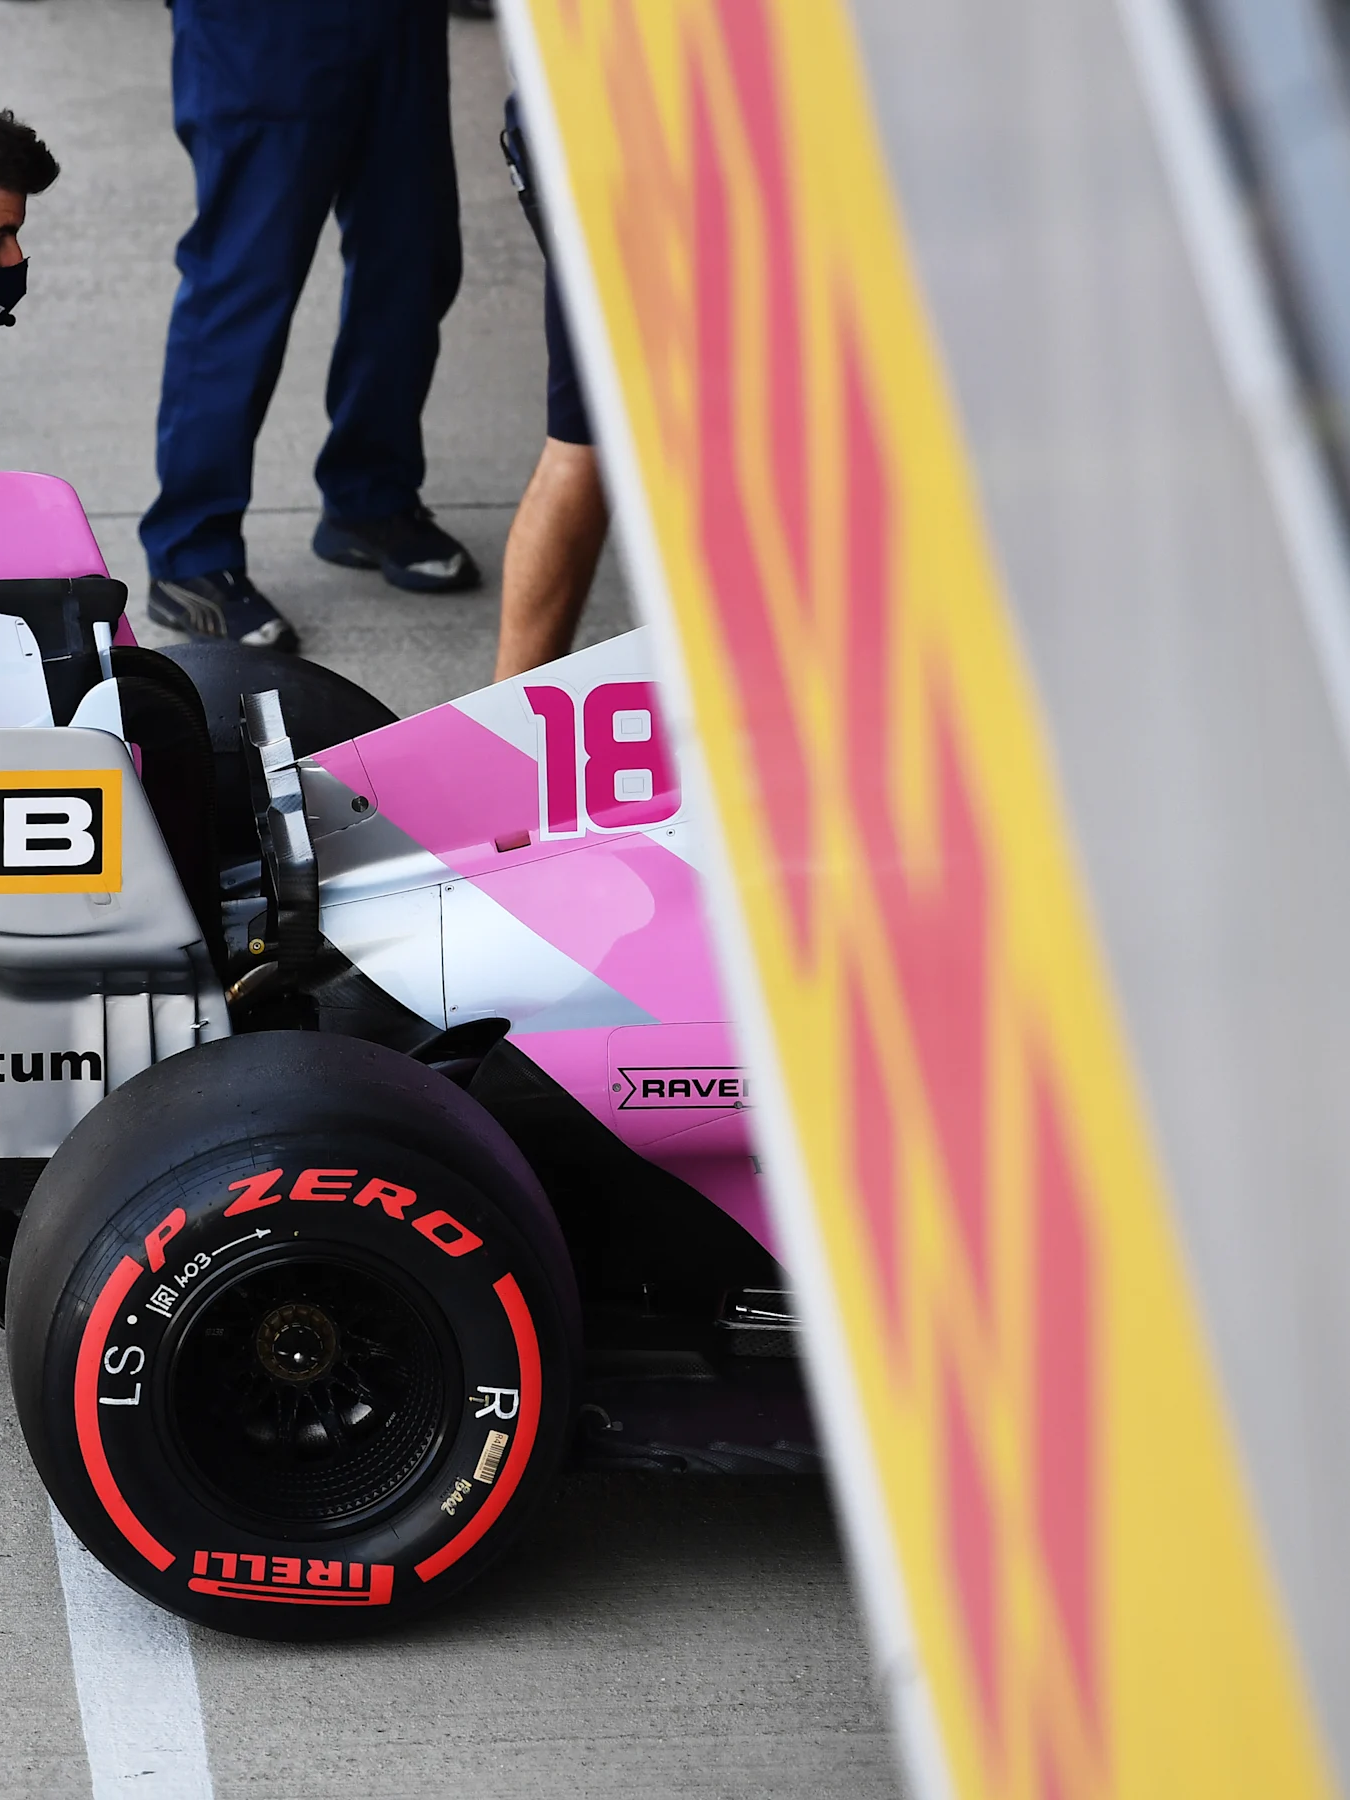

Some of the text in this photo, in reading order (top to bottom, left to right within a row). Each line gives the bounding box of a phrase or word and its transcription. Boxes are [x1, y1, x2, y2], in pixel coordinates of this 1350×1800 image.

[523, 680, 684, 834] 18
[144, 1167, 484, 1274] P ZERO
[173, 1250, 213, 1289] 403
[475, 1385, 520, 1420] R
[188, 1550, 395, 1607] PIRELLI
